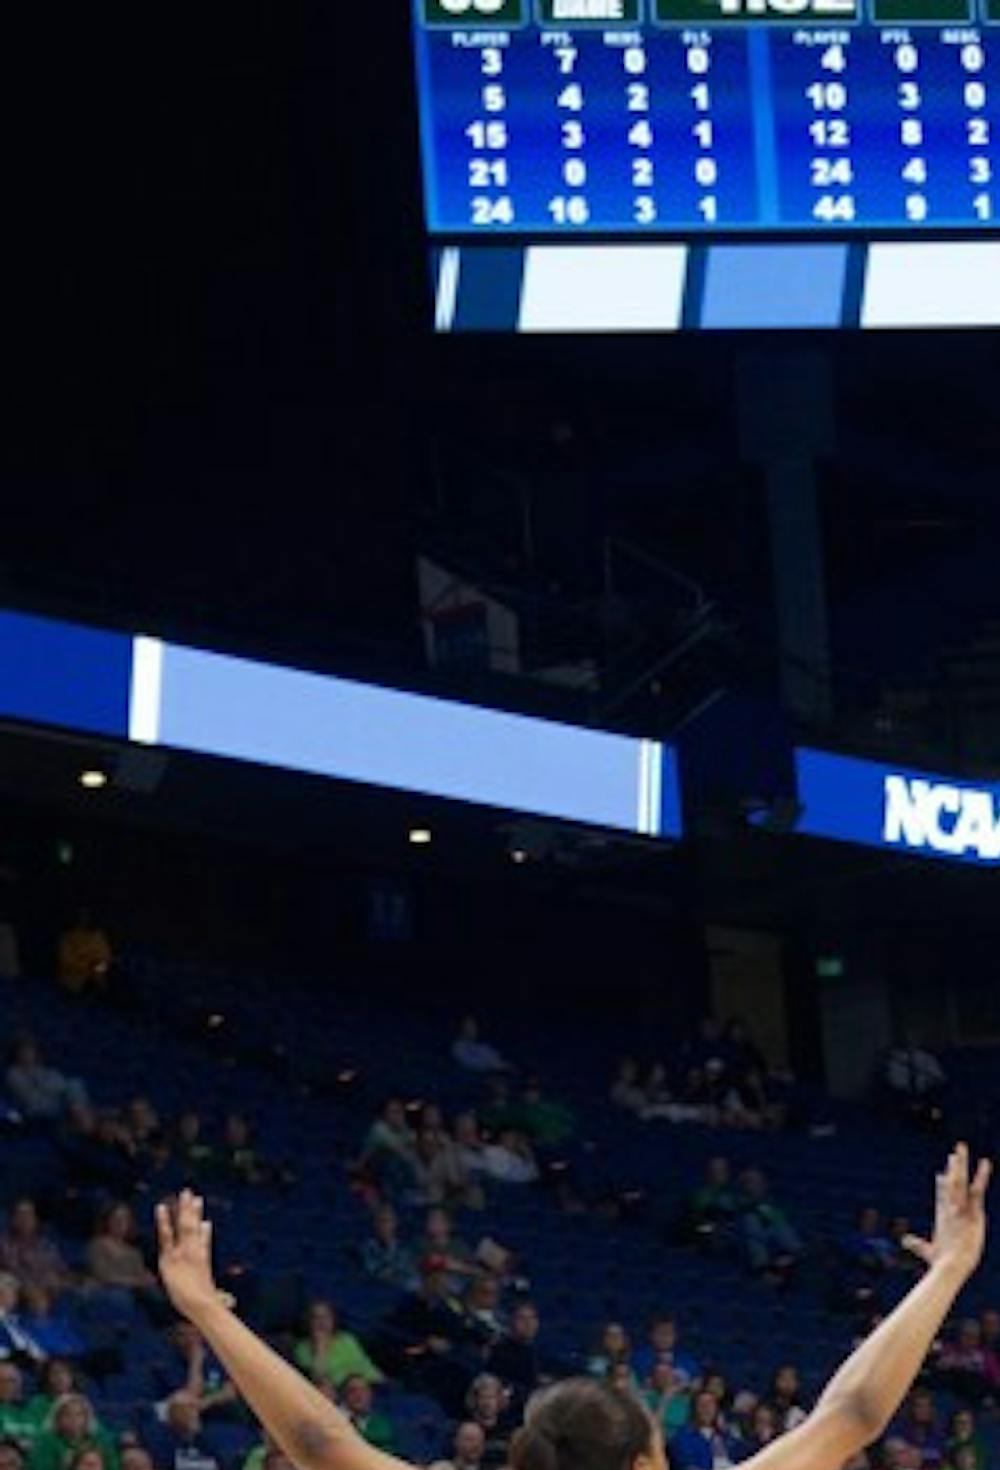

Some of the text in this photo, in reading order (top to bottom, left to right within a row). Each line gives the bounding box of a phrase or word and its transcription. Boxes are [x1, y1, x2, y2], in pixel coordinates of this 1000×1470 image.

[482, 46, 709, 74] 3 7 0 0
[821, 45, 846, 72] 4
[896, 44, 918, 72] 0
[961, 44, 984, 72] 0
[484, 83, 708, 112] 5 4 2 1
[806, 82, 847, 110] 10
[900, 82, 920, 110] 3
[964, 82, 985, 109] 0
[562, 121, 583, 149] 3
[628, 121, 652, 148] 4
[694, 120, 712, 148] 1
[809, 119, 848, 146] 12
[901, 119, 922, 146] 8
[968, 119, 988, 145] 2
[469, 158, 717, 187] 21 0 2 0
[811, 158, 852, 185] 24
[902, 157, 926, 183] 4
[970, 157, 990, 183] 3
[471, 196, 514, 224] 24
[635, 196, 655, 224] 3
[700, 196, 717, 223] 1
[813, 195, 855, 221] 44
[906, 194, 927, 221] 9
[973, 194, 990, 220] 1
